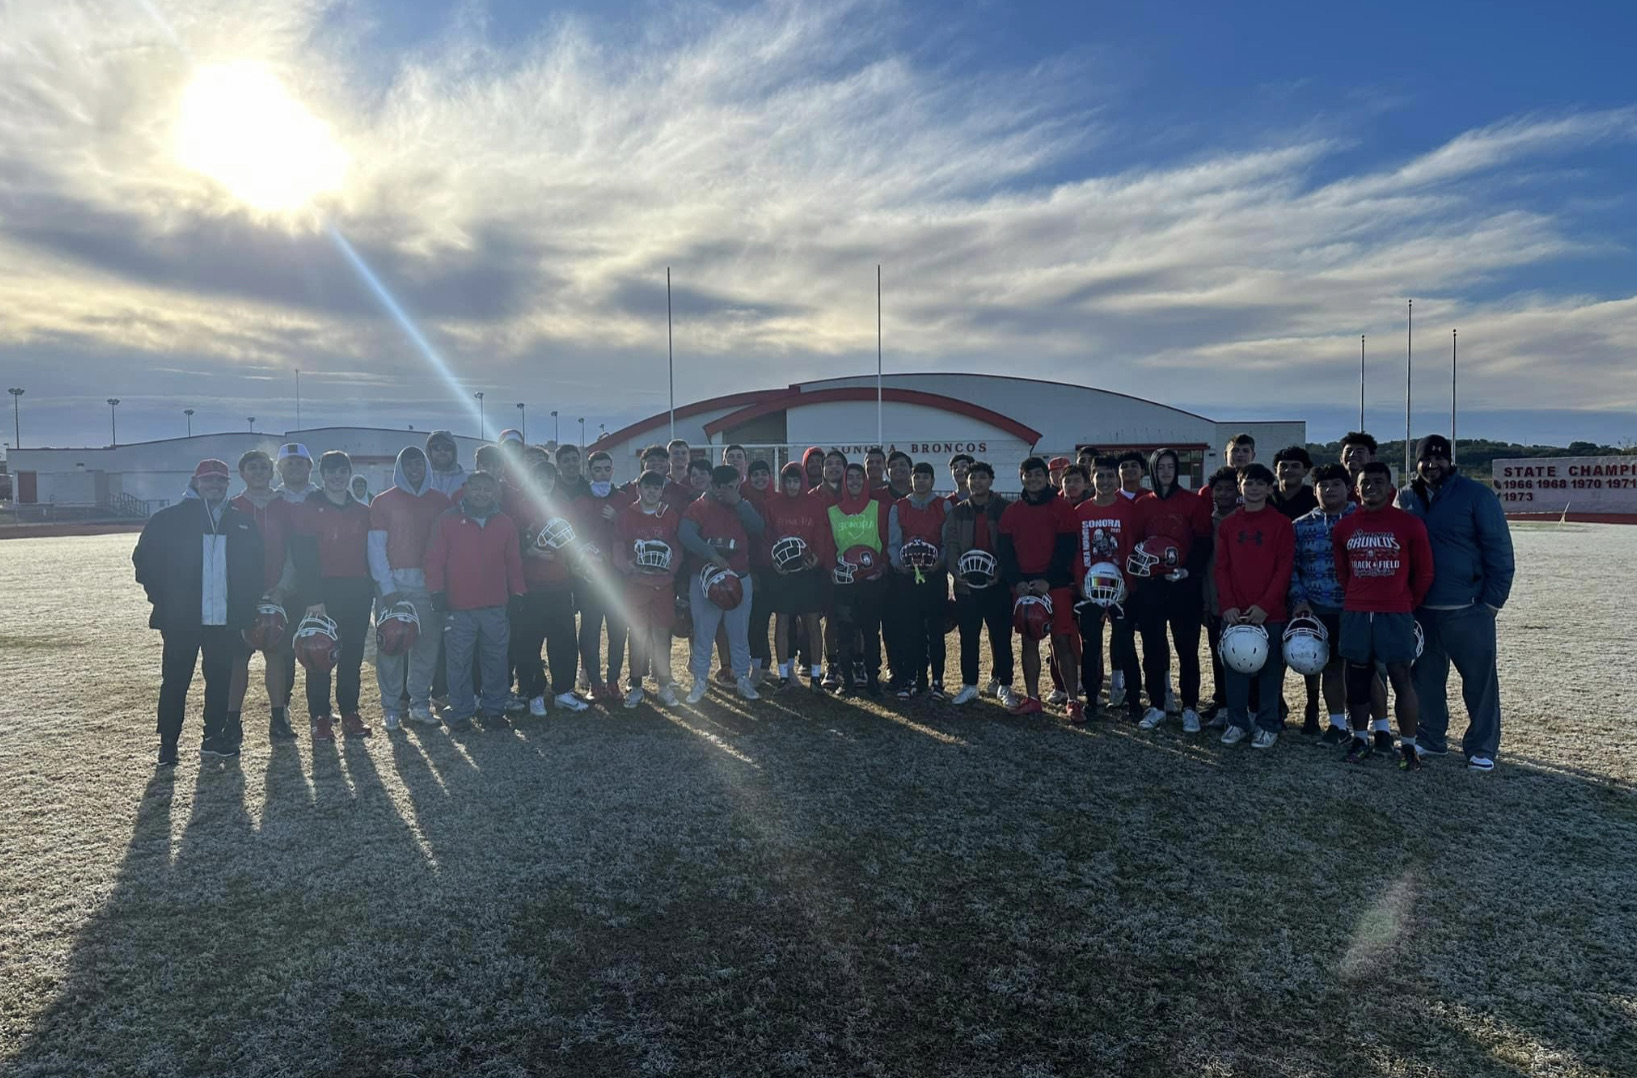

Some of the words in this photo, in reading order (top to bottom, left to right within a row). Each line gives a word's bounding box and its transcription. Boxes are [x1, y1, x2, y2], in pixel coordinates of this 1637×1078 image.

[911, 442, 987, 453] BRONCOS
[1504, 466, 1556, 477] STATE
[1568, 464, 1636, 477] CHAMPI
[1503, 479, 1533, 489] 1966
[1537, 479, 1567, 489] 1968
[1571, 479, 1602, 489] 1970
[1606, 478, 1636, 489] 1971
[1504, 492, 1533, 501] 1973
[838, 520, 875, 531] SONORA
[1082, 519, 1121, 529] SONORA
[1346, 536, 1401, 550] BRONCOS
[1378, 560, 1400, 569] FIELD
